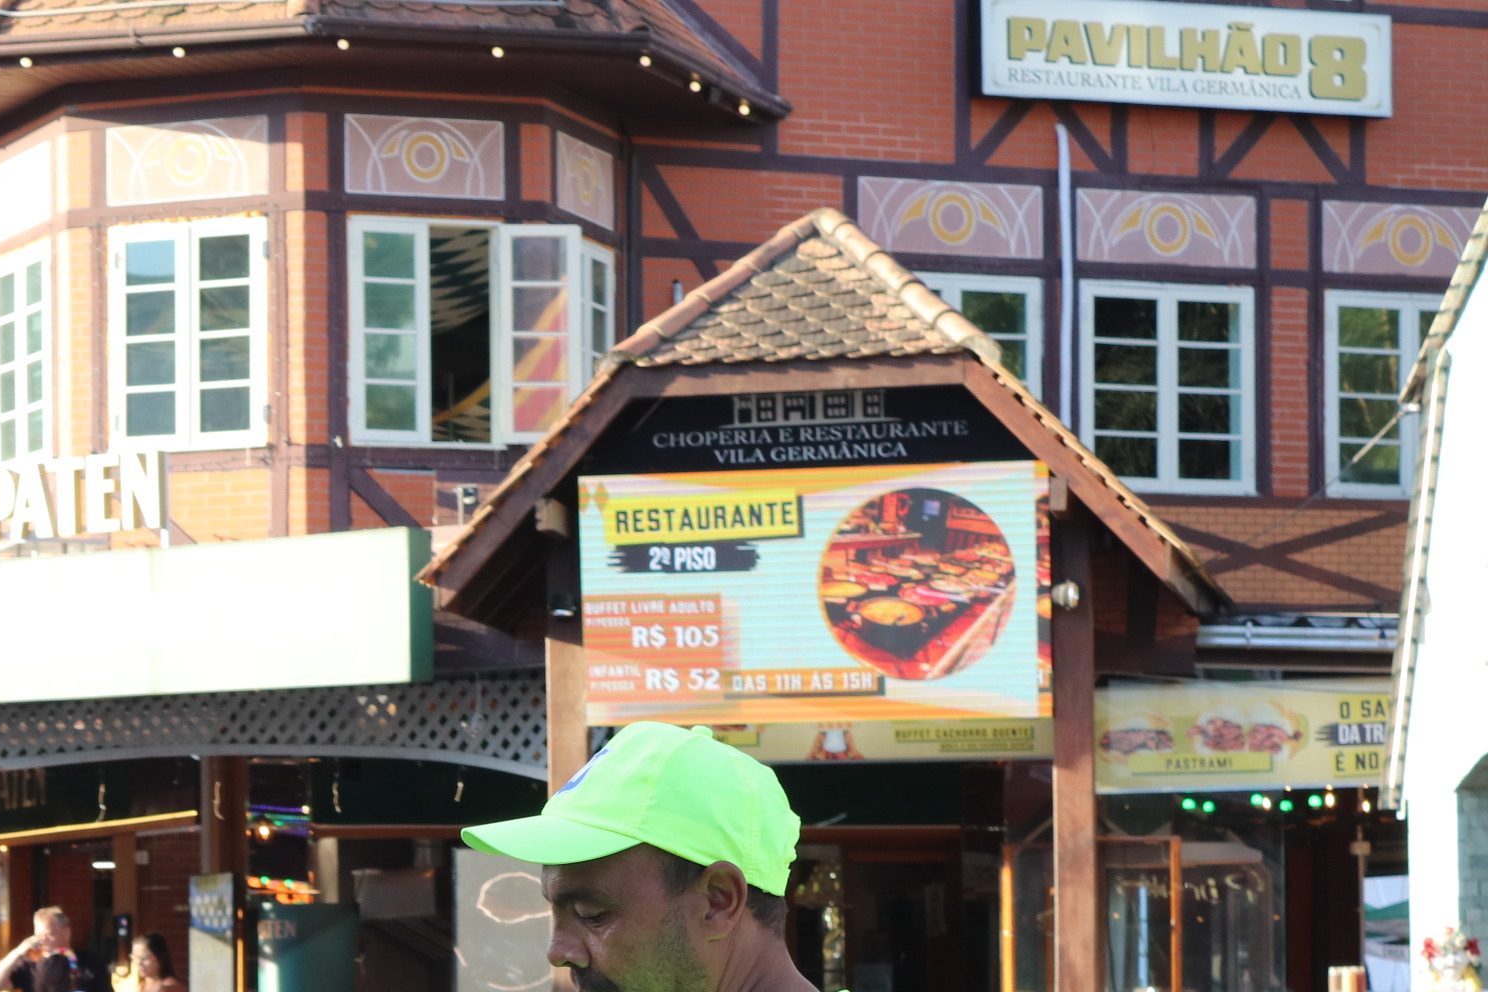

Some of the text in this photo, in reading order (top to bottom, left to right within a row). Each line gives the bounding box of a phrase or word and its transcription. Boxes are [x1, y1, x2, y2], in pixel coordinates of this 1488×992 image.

[1007, 17, 1368, 101] PAVILHÃO 8
[1007, 68, 1302, 99] RESTAURANTE VILA GERMÂNICA
[652, 421, 968, 448] CHOPERIA E RESTAURANTE
[713, 441, 908, 464] VILA GERMÂNICA
[616, 502, 794, 533] RESTAURANTE
[674, 546, 716, 571] PISO
[631, 624, 720, 649] R$ 105
[645, 667, 721, 693] R$ 52
[733, 675, 768, 692] DAS
[776, 673, 802, 691] 11H
[842, 672, 873, 690] 15H
[1340, 699, 1392, 719] O SA
[1338, 722, 1384, 744] DA TR
[1166, 758, 1233, 770] PASTRAMI
